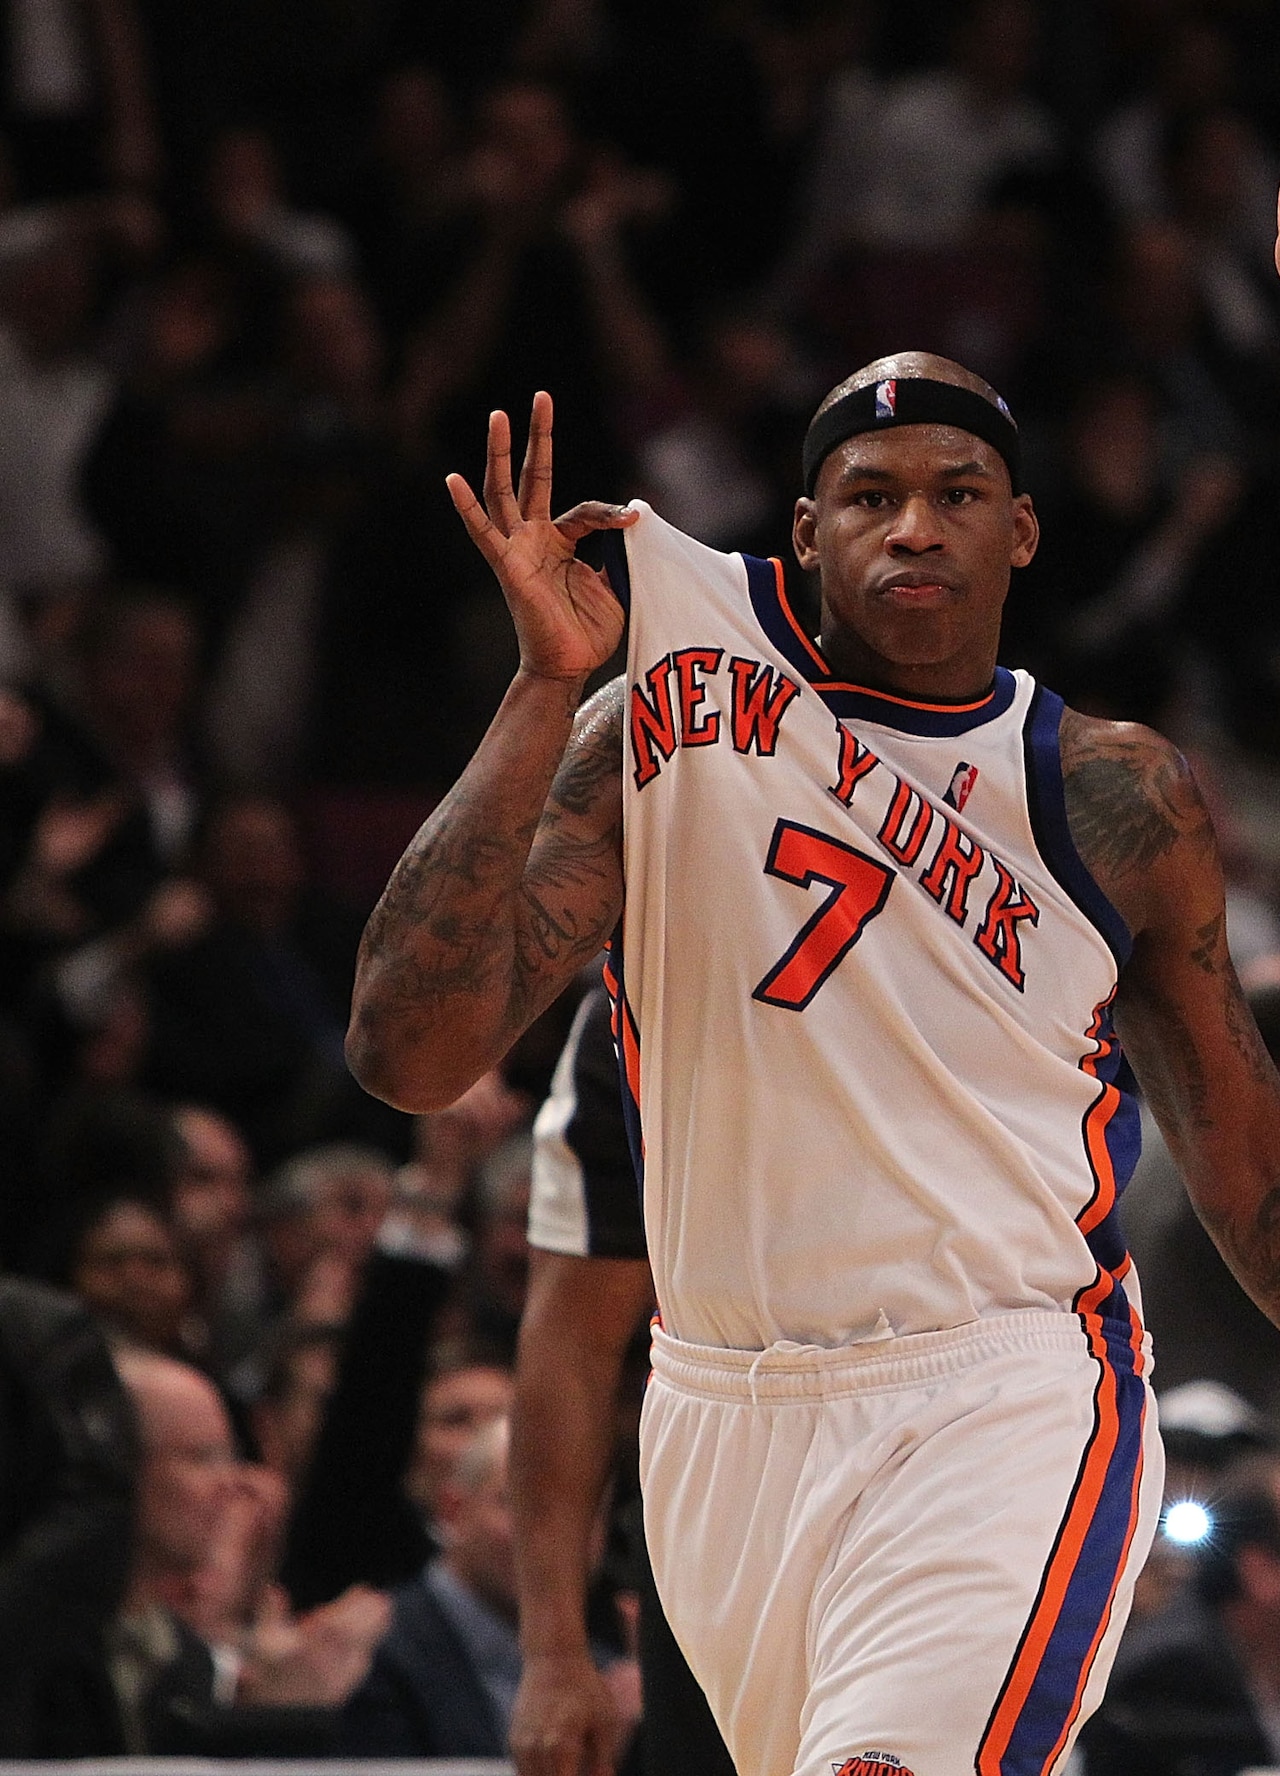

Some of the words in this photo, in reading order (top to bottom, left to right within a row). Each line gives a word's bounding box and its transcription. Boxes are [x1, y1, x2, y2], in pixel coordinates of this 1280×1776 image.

[627, 647, 801, 792] NEW
[827, 719, 1040, 994] YORK
[751, 817, 897, 1012] 7
[862, 1751, 881, 1760] NEW
[881, 1752, 901, 1766] YORK
